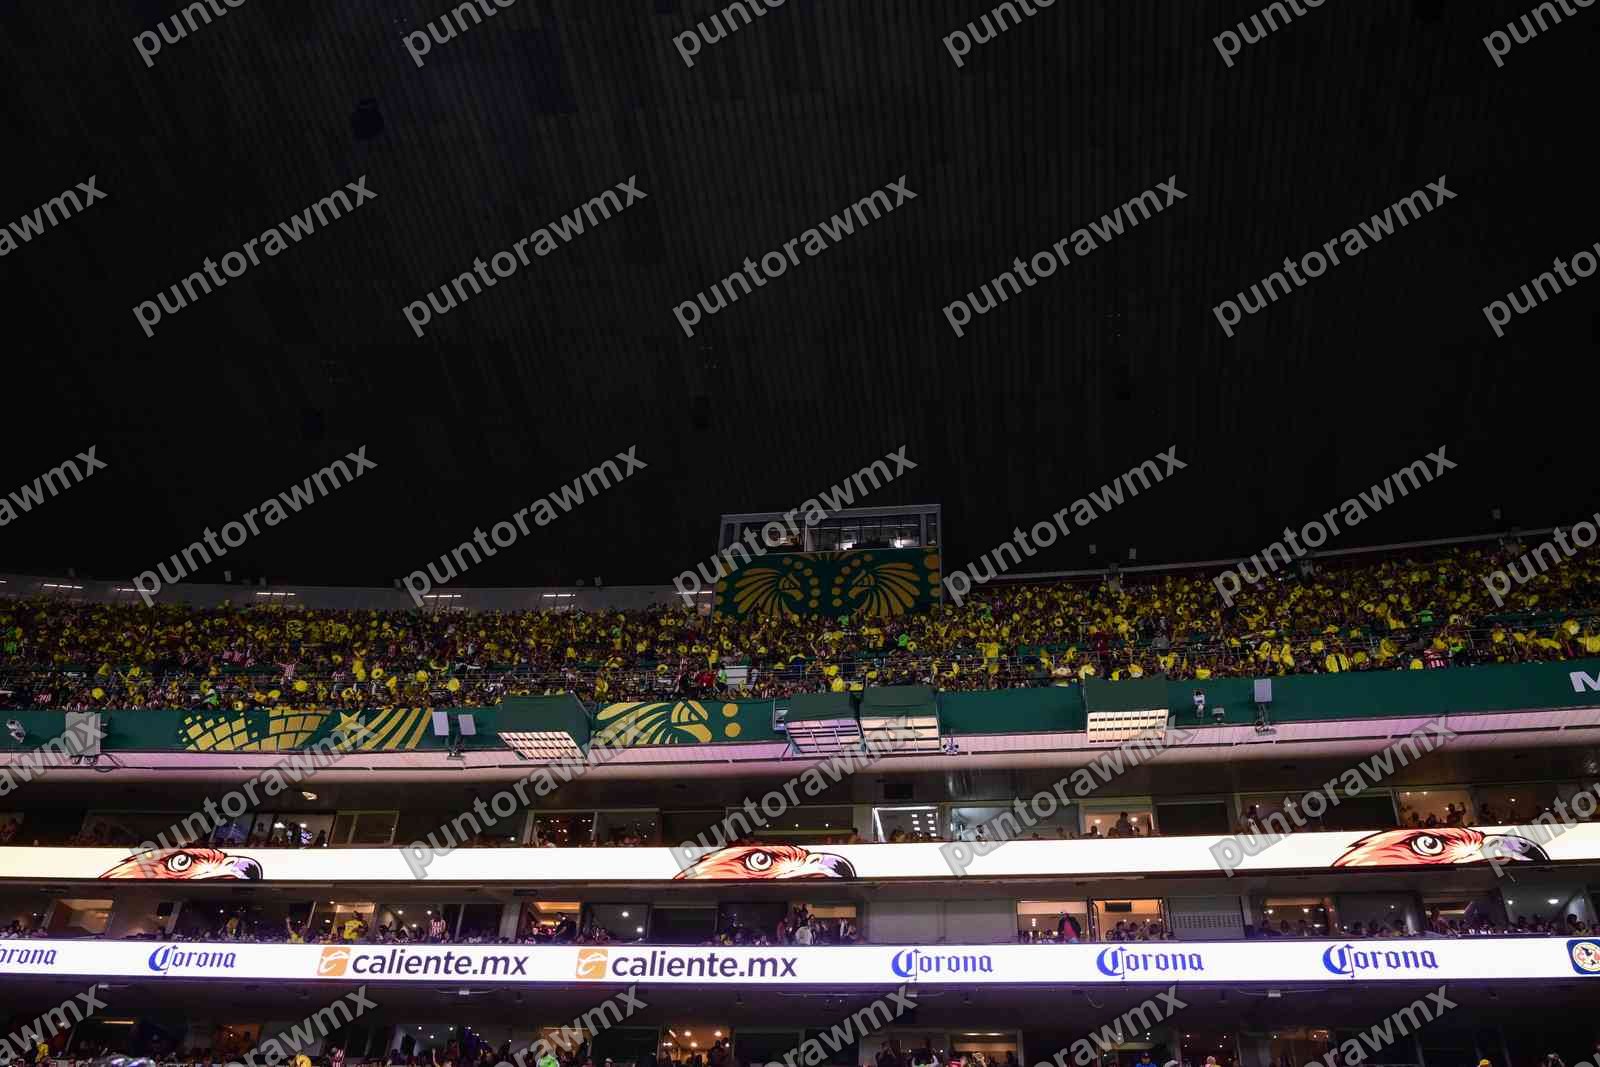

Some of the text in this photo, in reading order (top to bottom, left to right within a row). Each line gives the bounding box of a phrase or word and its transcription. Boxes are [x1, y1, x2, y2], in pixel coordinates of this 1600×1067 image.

[148, 945, 236, 974] Corona
[353, 949, 528, 976] caliente.mx
[612, 951, 797, 978] caliente.mx
[892, 949, 993, 980] Corona
[1097, 946, 1204, 979] Corona
[1323, 943, 1439, 978] Corona
